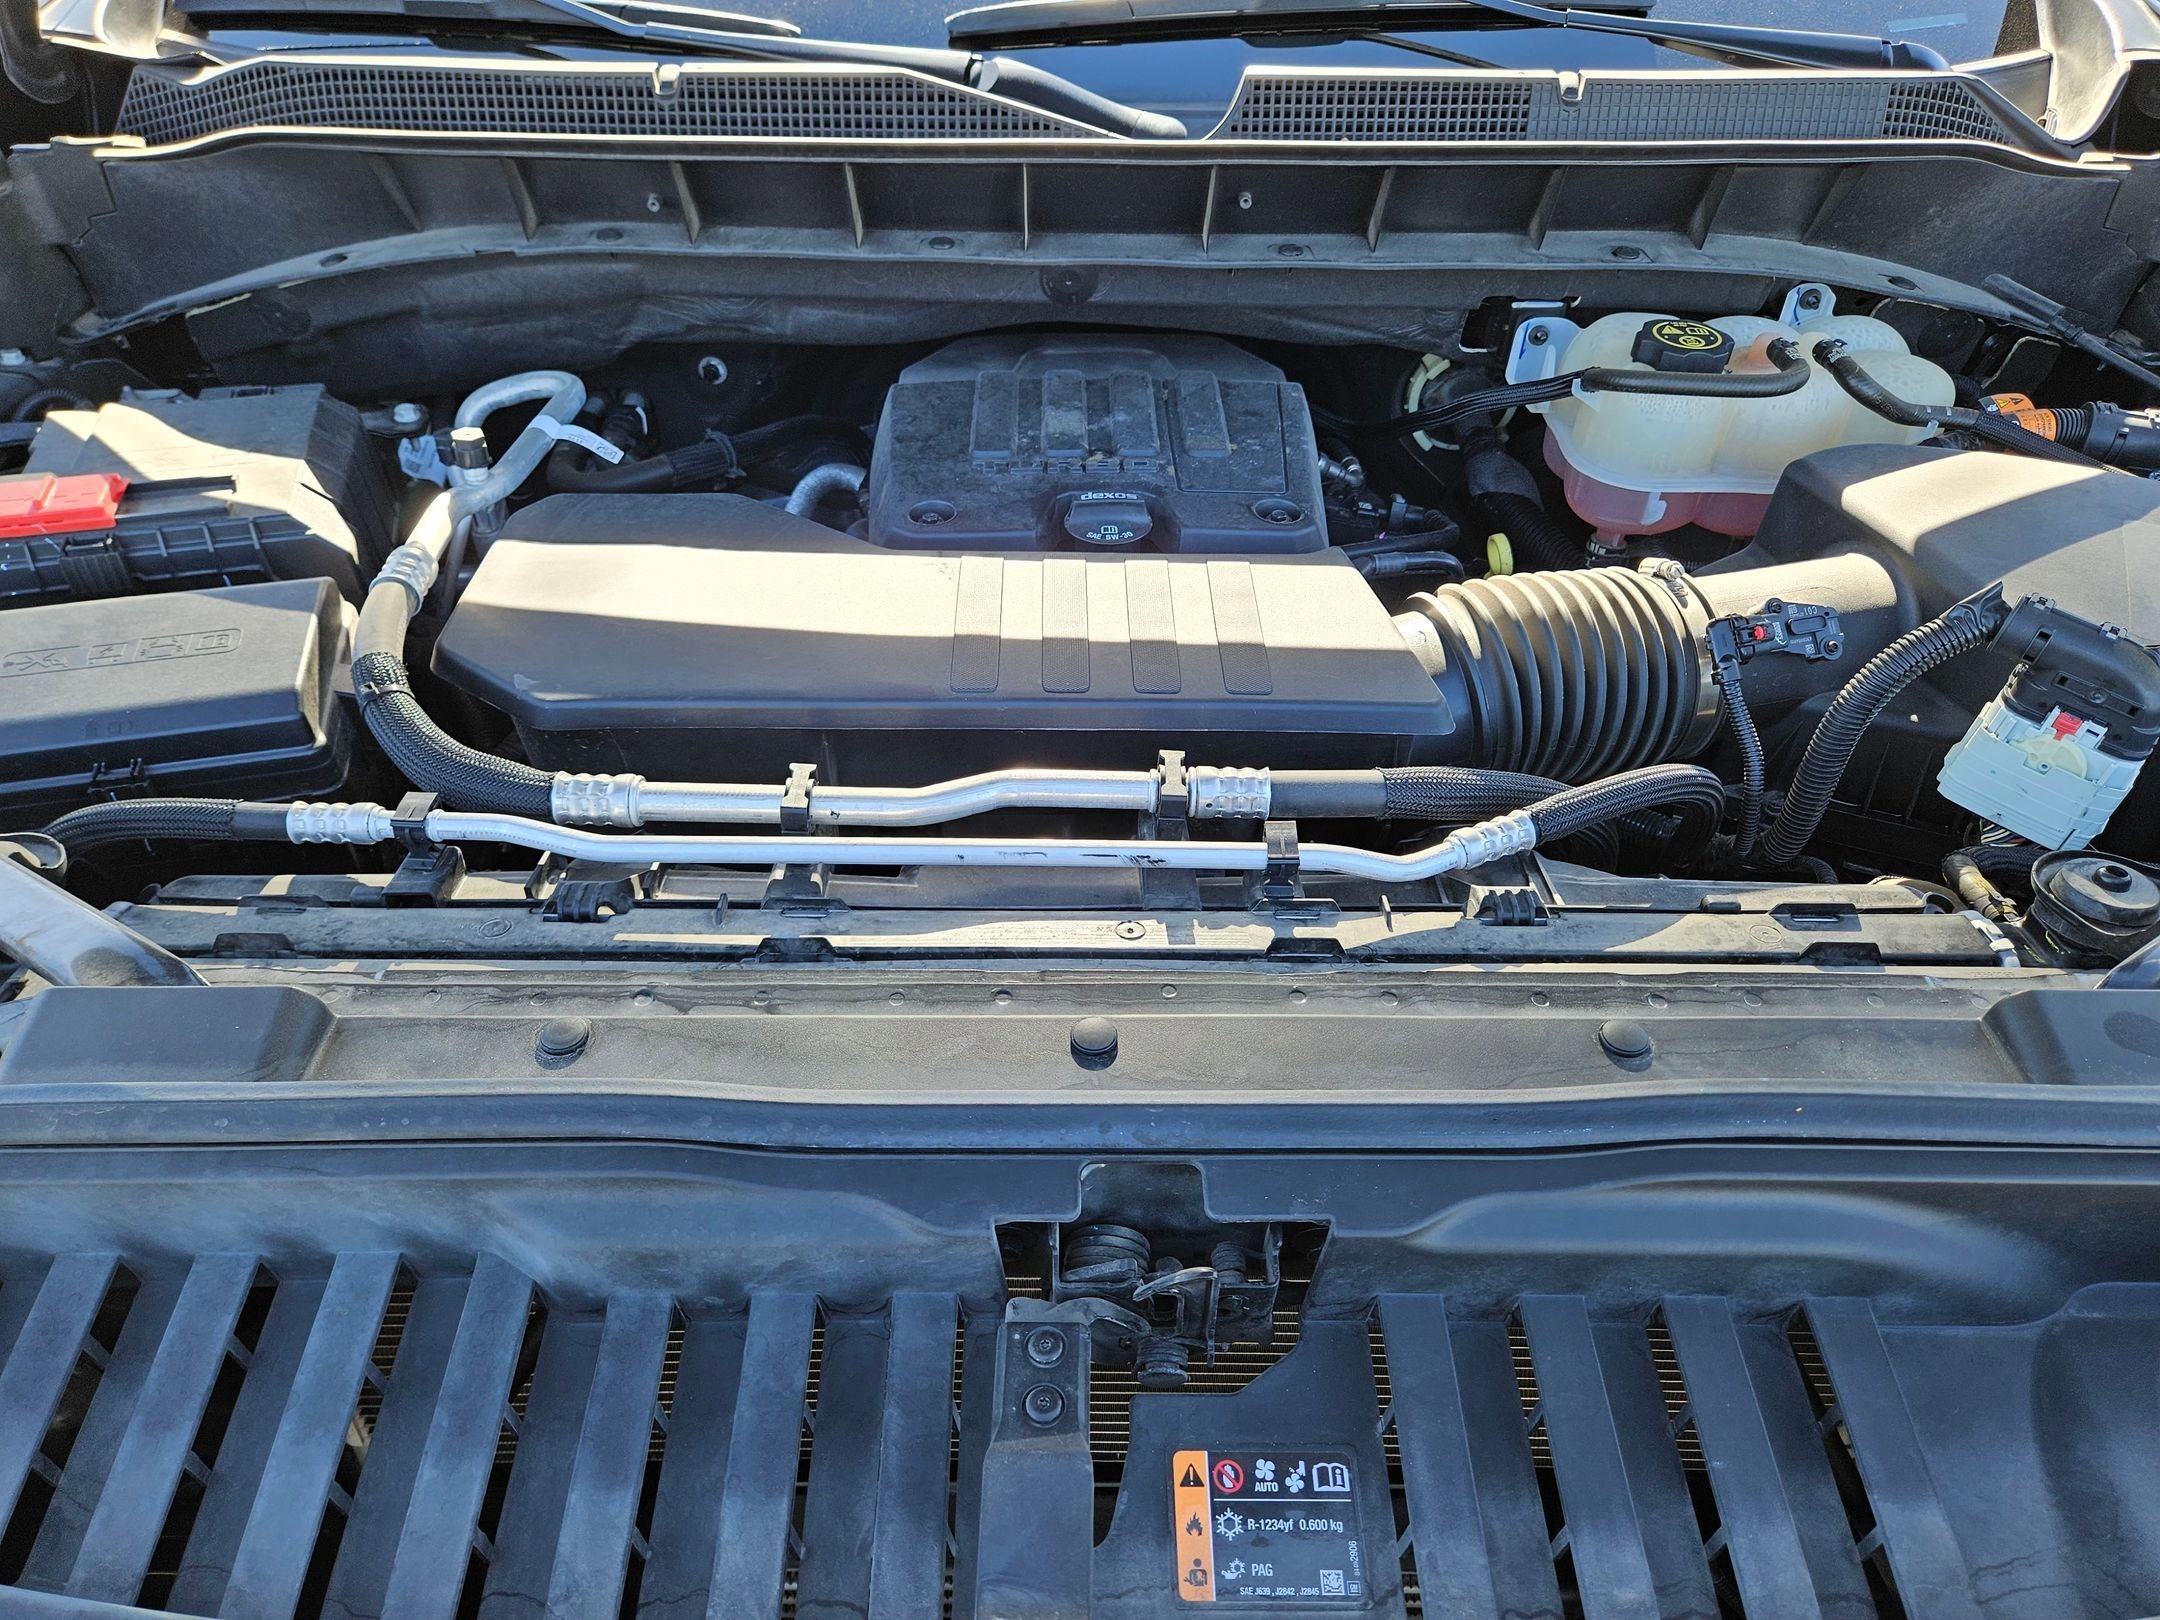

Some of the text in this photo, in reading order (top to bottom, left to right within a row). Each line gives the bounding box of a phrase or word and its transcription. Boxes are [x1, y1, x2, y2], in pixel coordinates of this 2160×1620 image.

[1081, 491, 1138, 500] dexos
[1086, 531, 1134, 540] SAE 5W-30
[1254, 1481, 1279, 1492] AUTO
[1247, 1518, 1344, 1533] R-1234yf 0.600 kg
[1251, 1563, 1274, 1577] PAG
[1239, 1586, 1254, 1596] SAE
